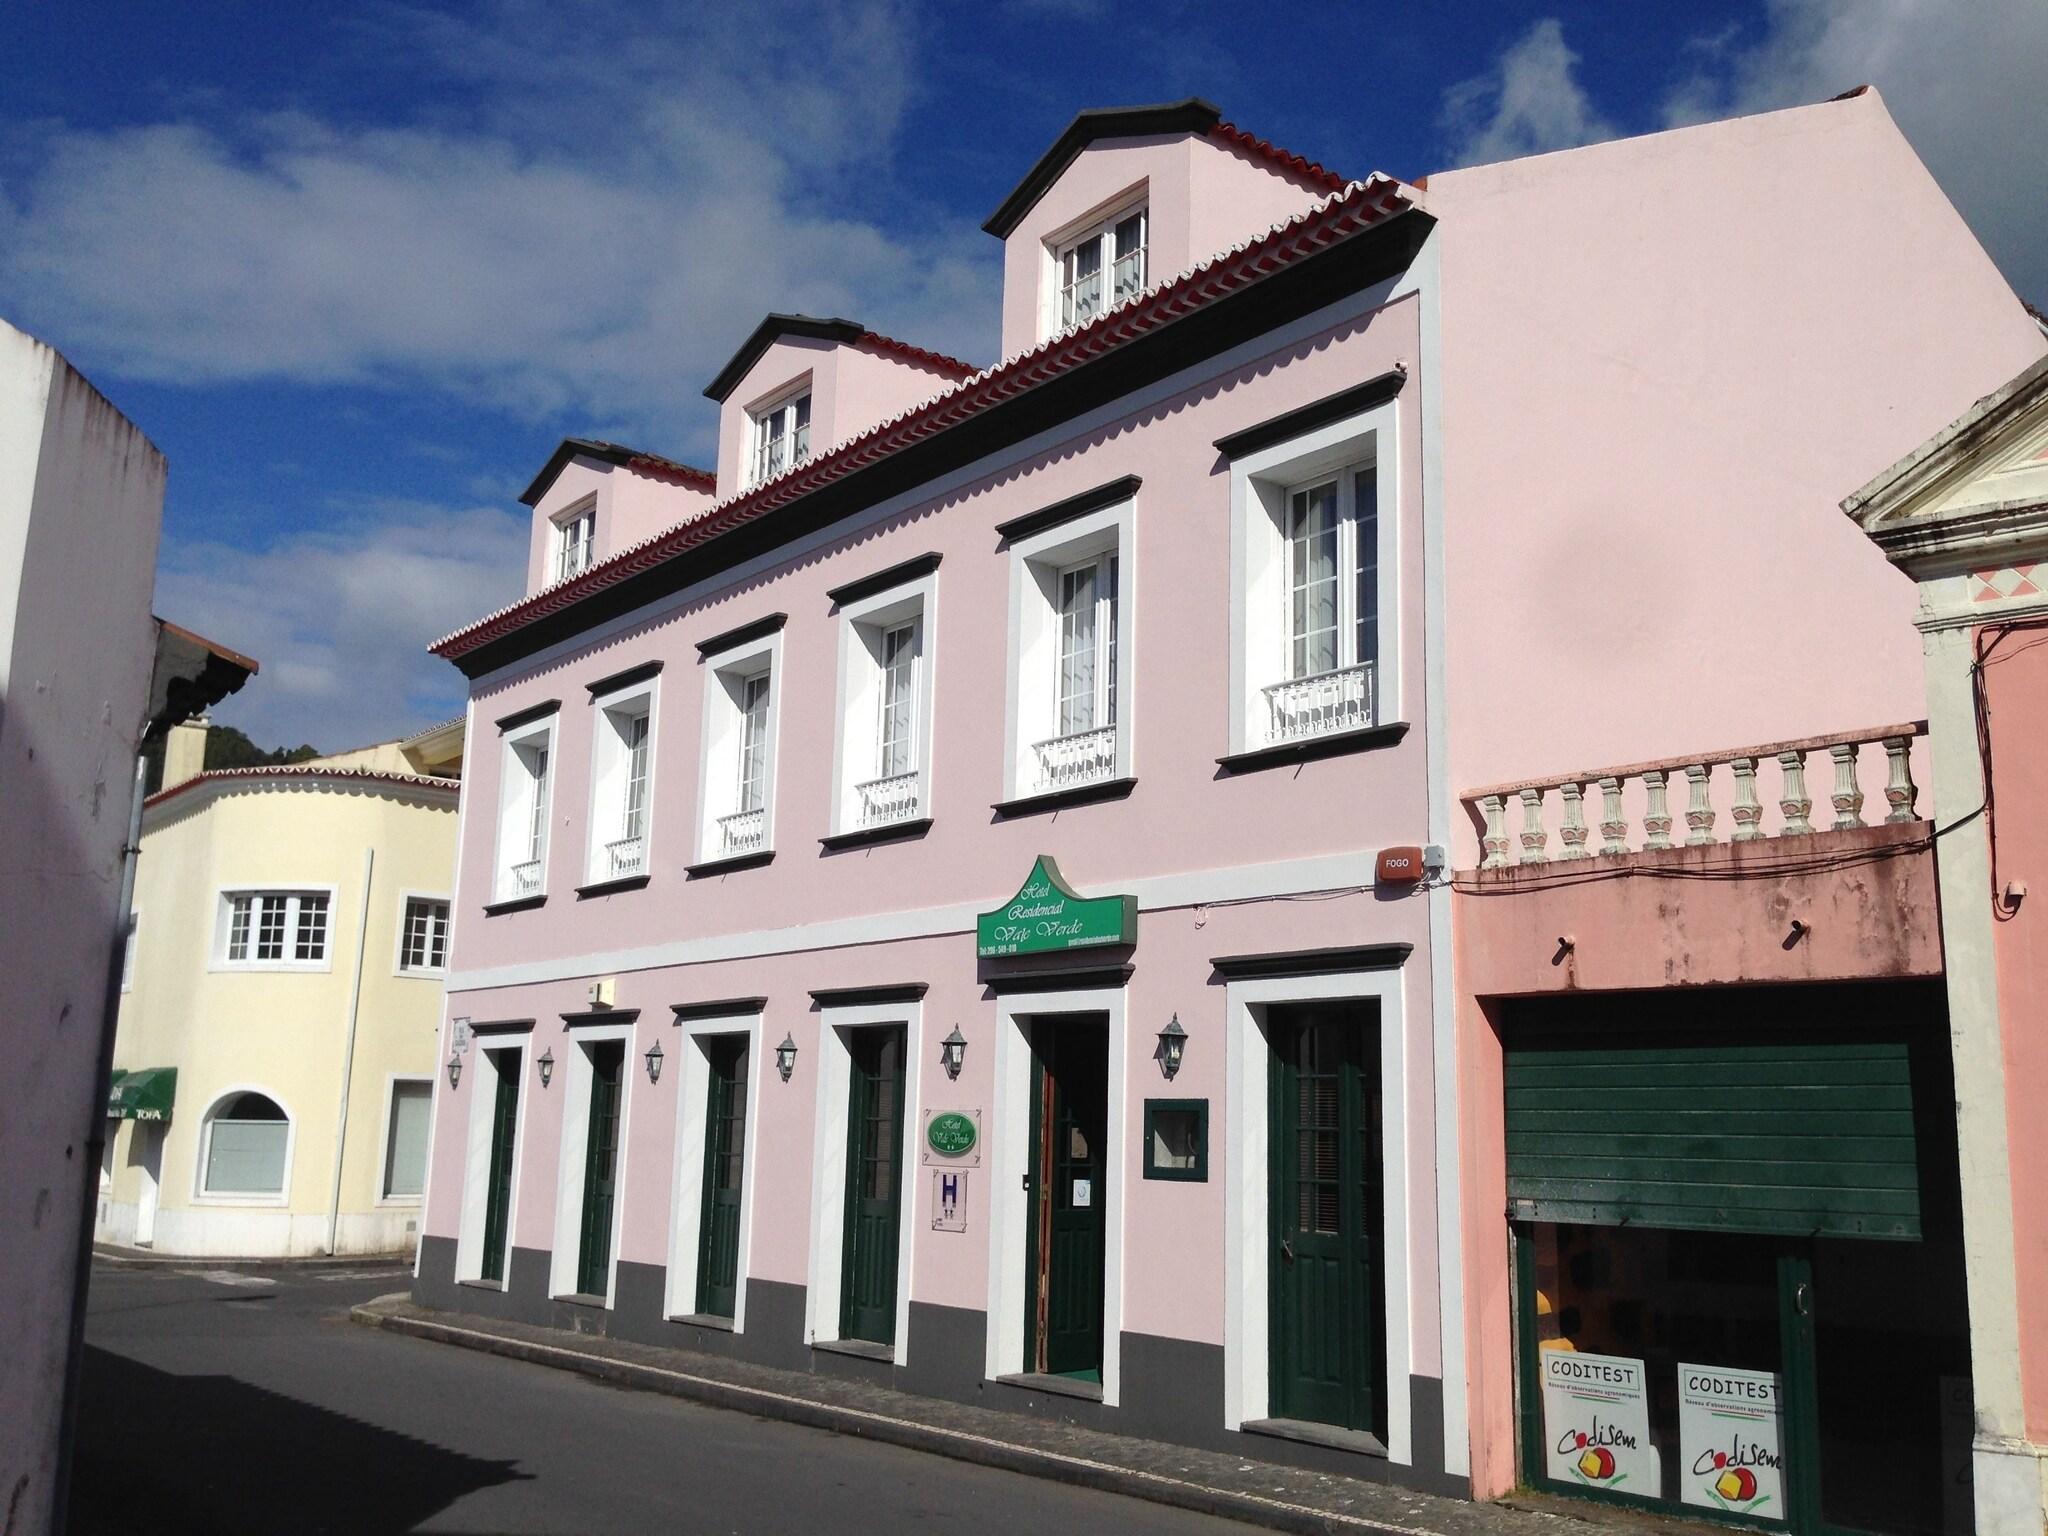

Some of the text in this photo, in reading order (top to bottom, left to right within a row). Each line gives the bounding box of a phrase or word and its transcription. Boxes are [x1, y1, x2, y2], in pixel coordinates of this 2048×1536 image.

[1386, 858, 1409, 868] FOGO
[1021, 883, 1049, 900] Hotel
[1009, 901, 1064, 920] Residencial
[1036, 920, 1082, 936] Verde
[1551, 1361, 1634, 1383] CODITEST
[1689, 1376, 1780, 1399] CODITEST
